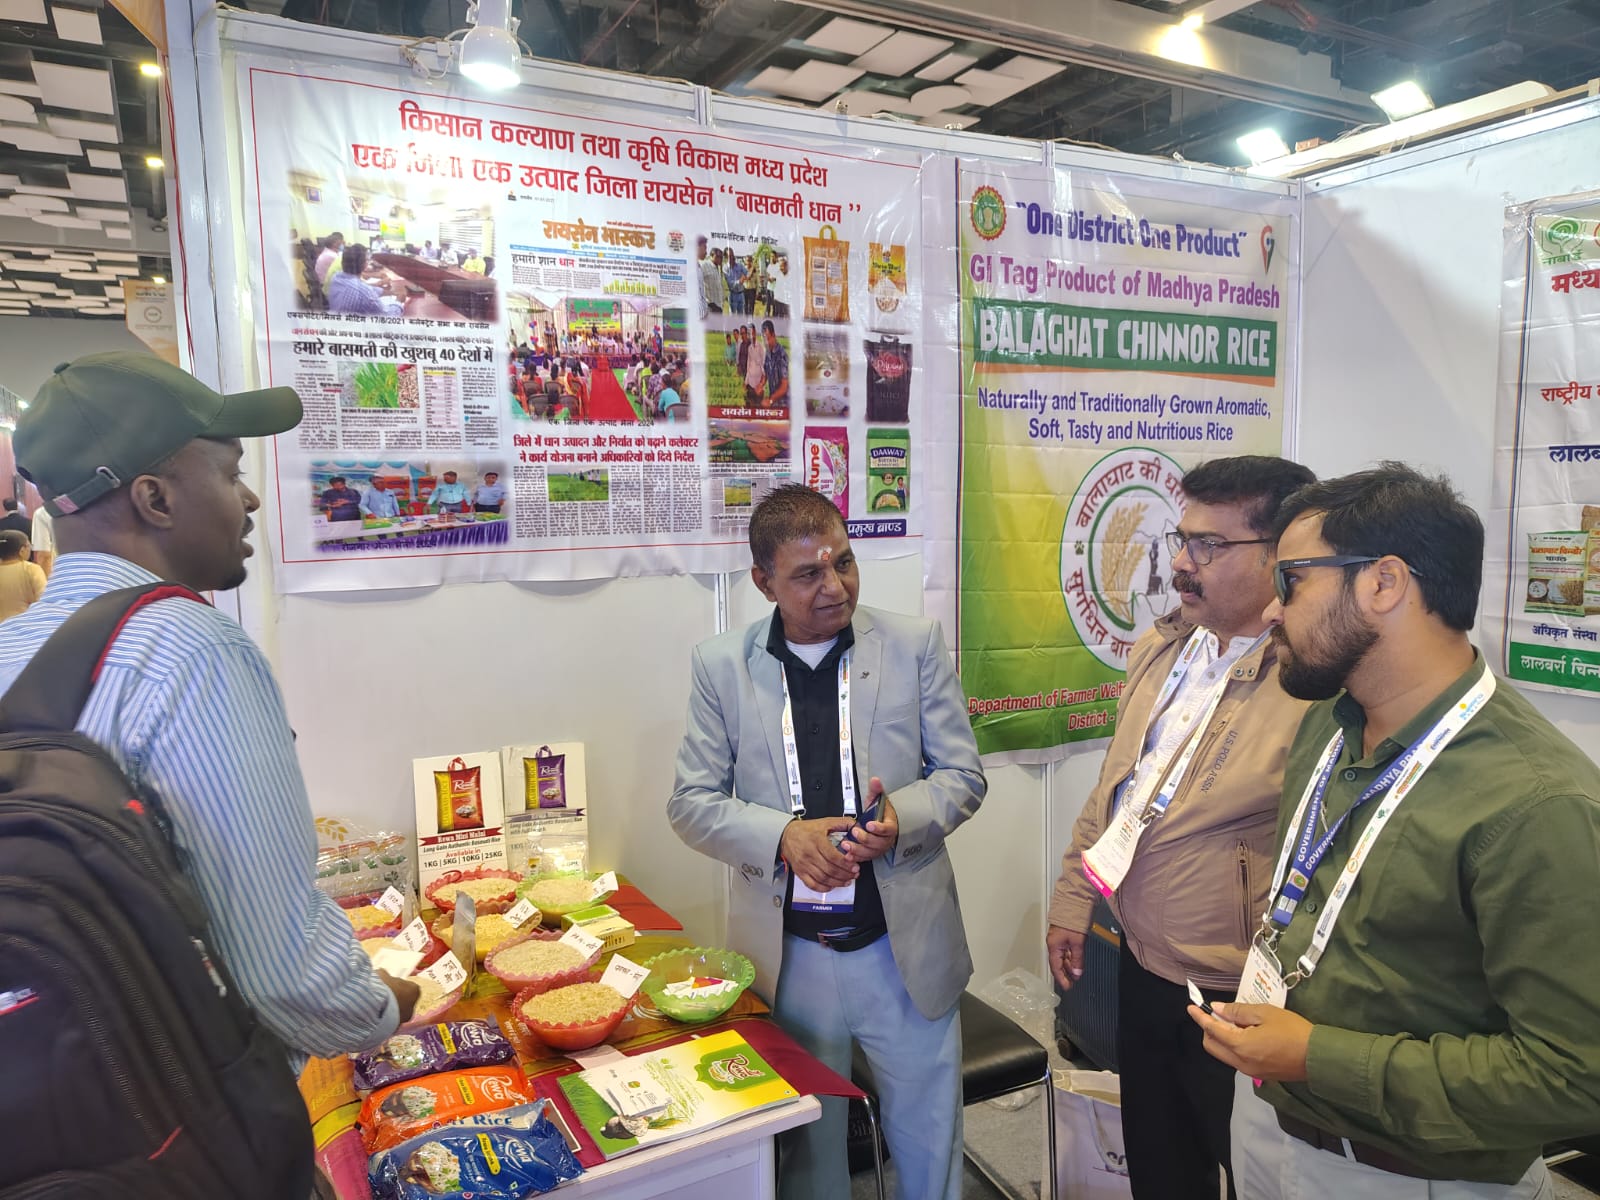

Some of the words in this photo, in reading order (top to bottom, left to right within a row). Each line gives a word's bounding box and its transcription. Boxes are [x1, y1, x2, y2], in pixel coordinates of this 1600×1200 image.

[398, 99, 483, 141] किसान
[489, 120, 575, 153] कल्याण
[580, 132, 620, 160] तथा
[626, 136, 669, 172] कृषि
[676, 139, 738, 174] विकास
[744, 155, 783, 181] मध्य
[789, 157, 828, 188] प्रदेश
[352, 144, 398, 170] एक
[472, 158, 512, 183] एक
[519, 164, 579, 193] उत्पाद
[585, 165, 637, 200] जिला
[643, 177, 714, 208] रायसेन
[809, 201, 841, 224] धान
[542, 218, 599, 244] रायसेन
[601, 225, 656, 250] भास्कर
[1068, 208, 1134, 245] District
[1138, 218, 1171, 250] One
[511, 252, 535, 265] हमारी
[970, 254, 992, 283] GI
[1000, 256, 1038, 294] Tag
[1046, 260, 1116, 296] Product
[1122, 269, 1142, 296] of
[1147, 271, 1212, 308] Madhya
[1218, 277, 1280, 309] Pradesh
[1551, 267, 1600, 294] मध्य
[293, 337, 325, 355] हमारे
[327, 341, 377, 358] बासमती
[379, 341, 398, 358] की
[401, 346, 438, 364] खुशबू
[439, 348, 455, 361] 40
[457, 344, 482, 363] देशों
[484, 345, 494, 363] में
[979, 309, 1109, 359] BALAGHAT
[1117, 319, 1219, 365] CHINNOR
[1226, 327, 1271, 367] RICE
[977, 387, 1048, 415] Naturally
[1051, 391, 1076, 410] and
[1080, 391, 1166, 417] Traditionally
[1169, 393, 1213, 415] Grown
[1215, 395, 1271, 419] Aromatic,
[1540, 381, 1592, 405] राष्ट्रीय
[721, 407, 752, 417] रायसेन
[513, 433, 531, 447] जिले
[534, 434, 542, 447] में
[562, 437, 589, 447] उत्पादन
[592, 434, 606, 447] और
[609, 434, 632, 447] निर्यात
[635, 434, 645, 447] को
[668, 435, 699, 447] कलेक्टर
[1028, 417, 1064, 441] Soft,
[1067, 418, 1103, 444] Tasty
[1107, 420, 1132, 439] and
[1136, 420, 1203, 441] Nutritious
[1206, 421, 1233, 441] Rice
[520, 450, 526, 462] ने
[528, 450, 547, 462] कार्य
[550, 450, 575, 462] योजना
[577, 450, 597, 462] बनाने
[644, 450, 655, 462] को
[658, 450, 672, 462] दिये
[674, 450, 694, 462] निर्देश
[872, 448, 905, 457] DAAWAT
[1076, 462, 1134, 528] बालाघाट
[1138, 458, 1161, 483] की
[1532, 623, 1569, 641] अधिकृत
[1572, 626, 1597, 641] संस्था
[968, 694, 1043, 715] Department
[1045, 690, 1057, 707] of
[1060, 688, 1098, 705] Farmer
[1100, 681, 1126, 699] Welf
[1068, 711, 1107, 731] District
[1214, 747, 1230, 771] POLO
[1362, 767, 1401, 801] MADHYA
[1298, 790, 1321, 862] GOVERNMENT
[424, 860, 438, 868] 1KG
[443, 857, 457, 865] 5KG
[462, 854, 480, 862] 10KG
[485, 851, 503, 859] 25KG
